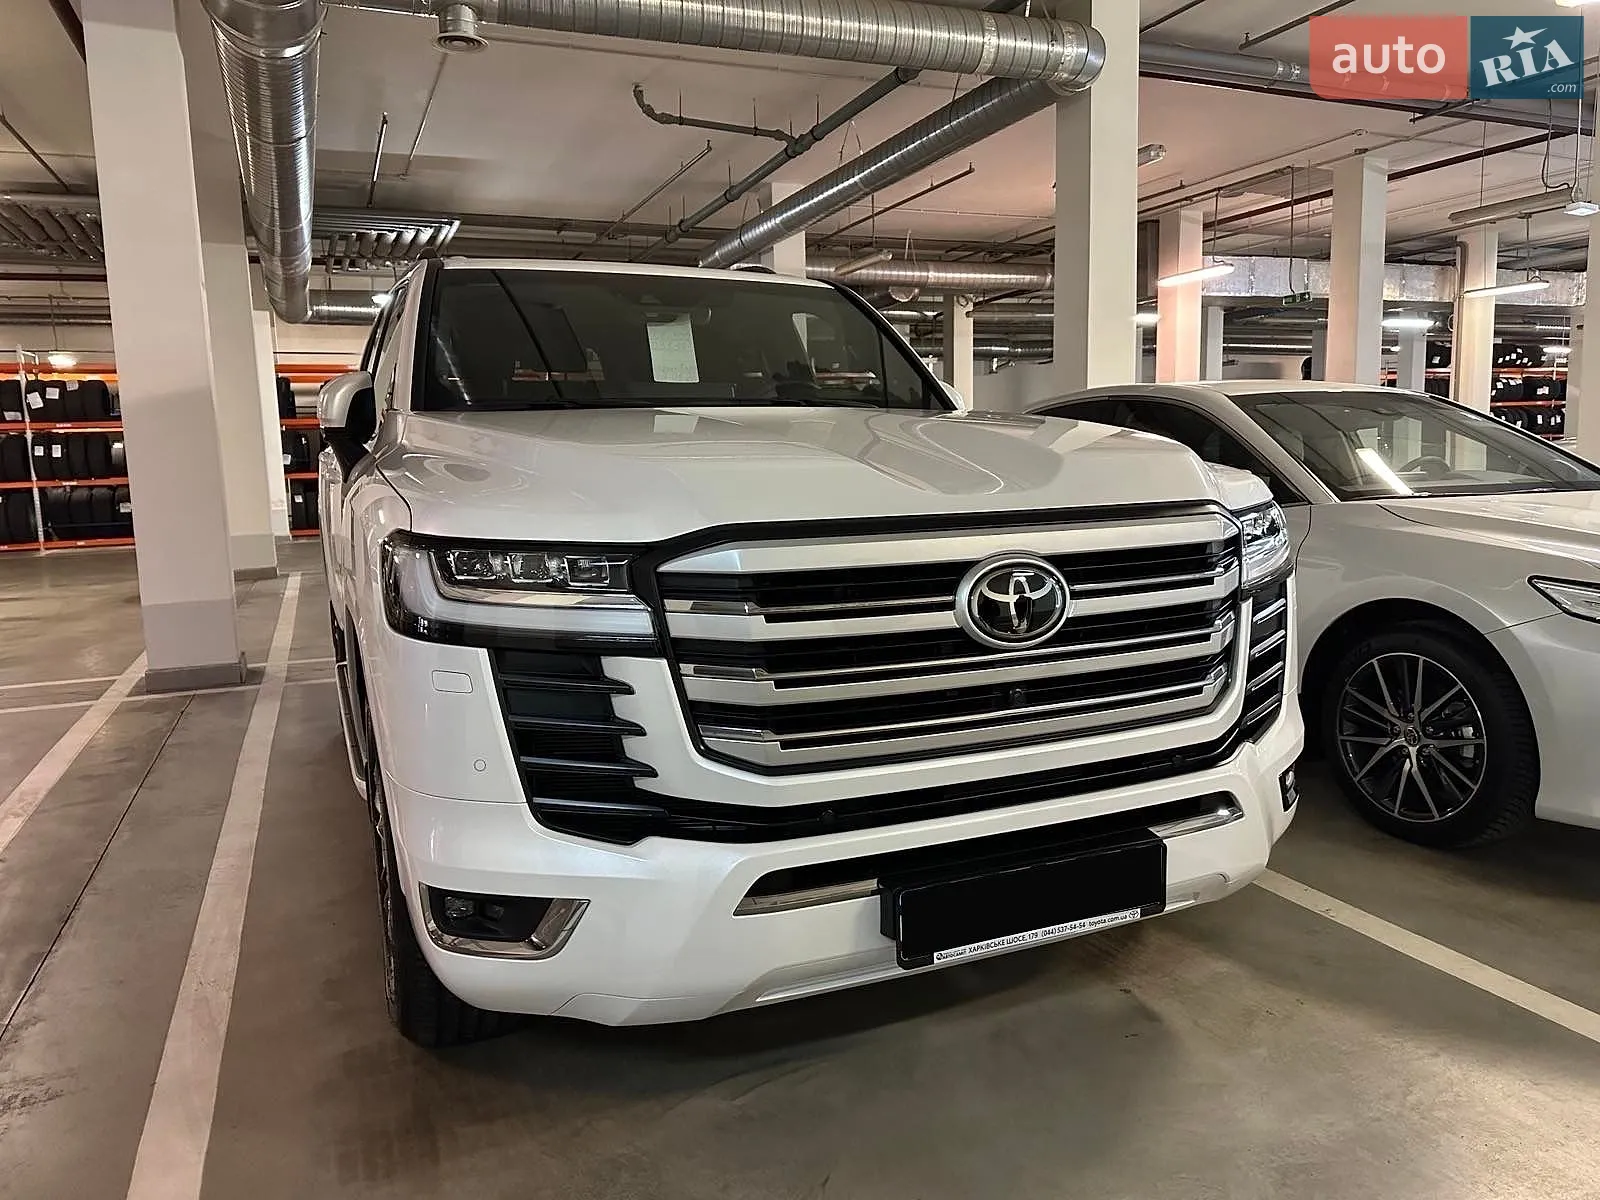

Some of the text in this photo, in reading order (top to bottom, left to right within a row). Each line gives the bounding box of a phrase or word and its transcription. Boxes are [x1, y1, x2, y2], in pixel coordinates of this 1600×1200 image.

[968, 939, 1006, 954] ХАРКІВСЬКЕ
[1028, 931, 1038, 940] 179
[1041, 927, 1057, 938] (044)
[1057, 922, 1086, 933] 537-54-54
[1088, 915, 1128, 927] toyota.com.ua
